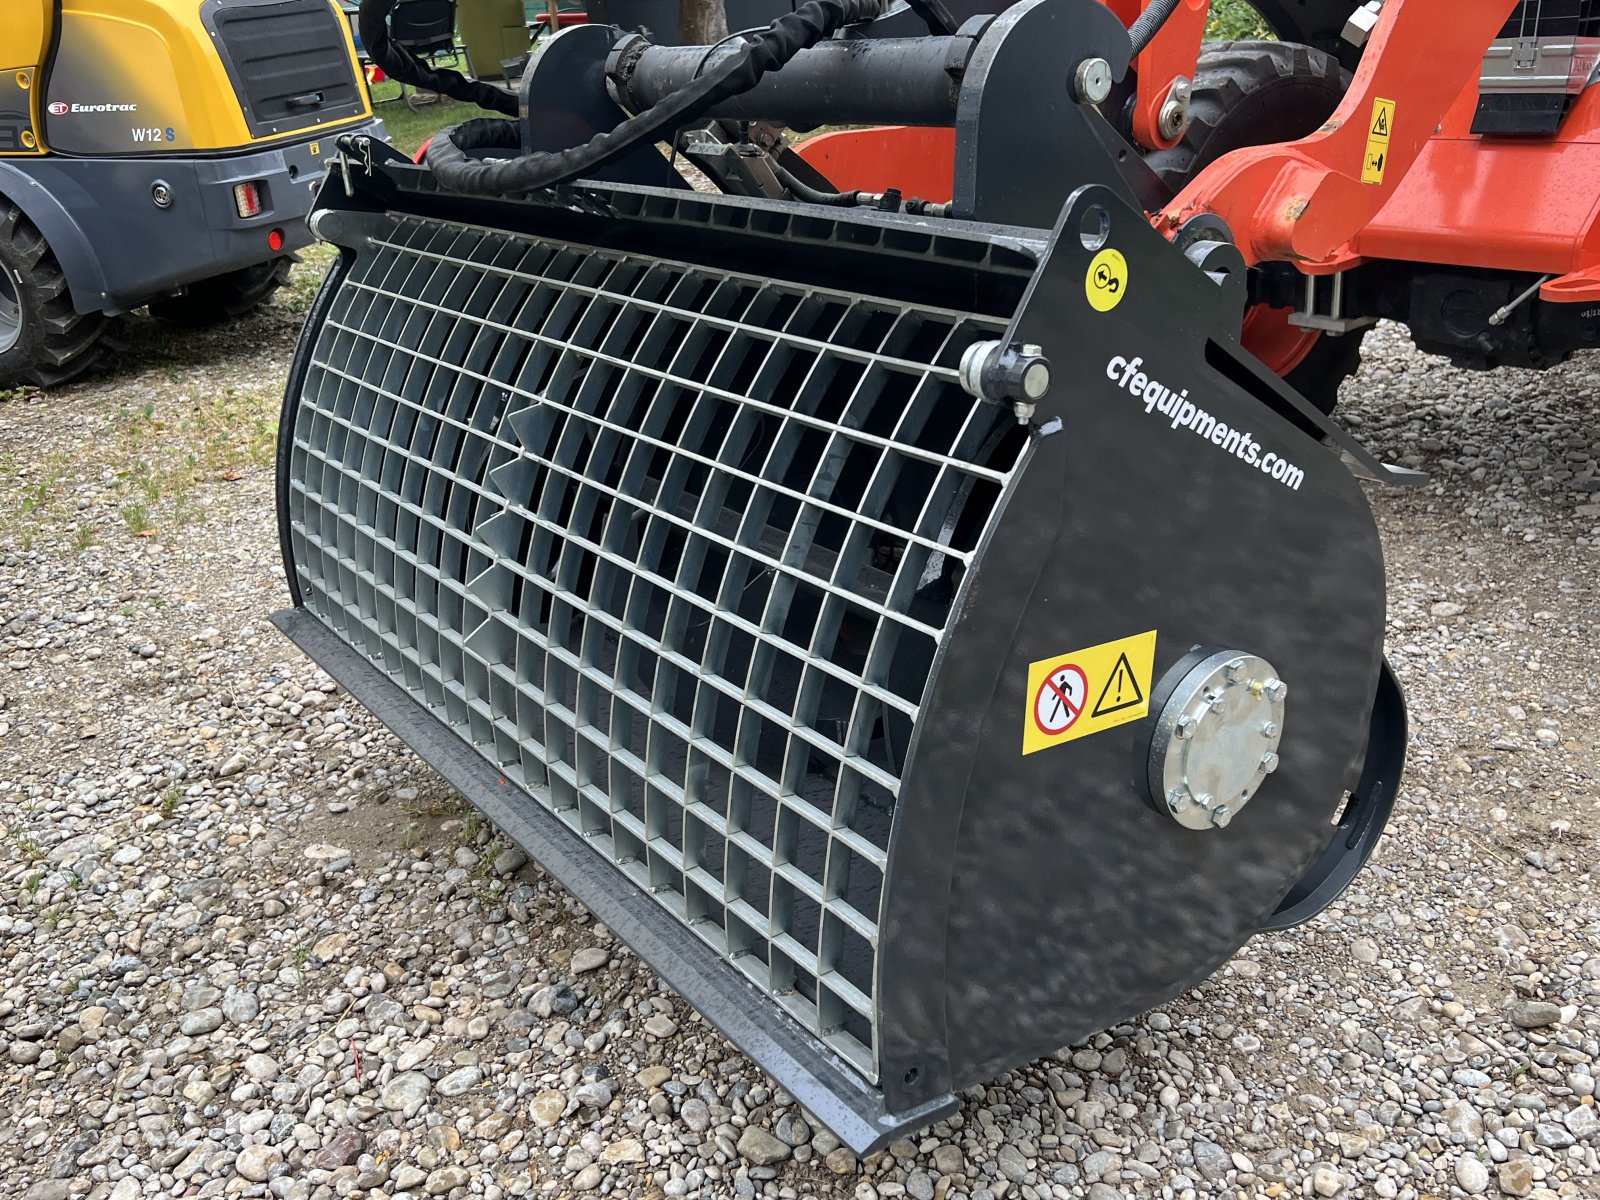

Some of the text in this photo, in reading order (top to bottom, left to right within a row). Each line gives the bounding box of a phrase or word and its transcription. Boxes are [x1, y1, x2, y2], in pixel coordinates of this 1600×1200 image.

[50, 103, 137, 114] ET Eurotrac
[131, 127, 176, 142] W12 S
[1106, 355, 1305, 491] cfequipments.com
